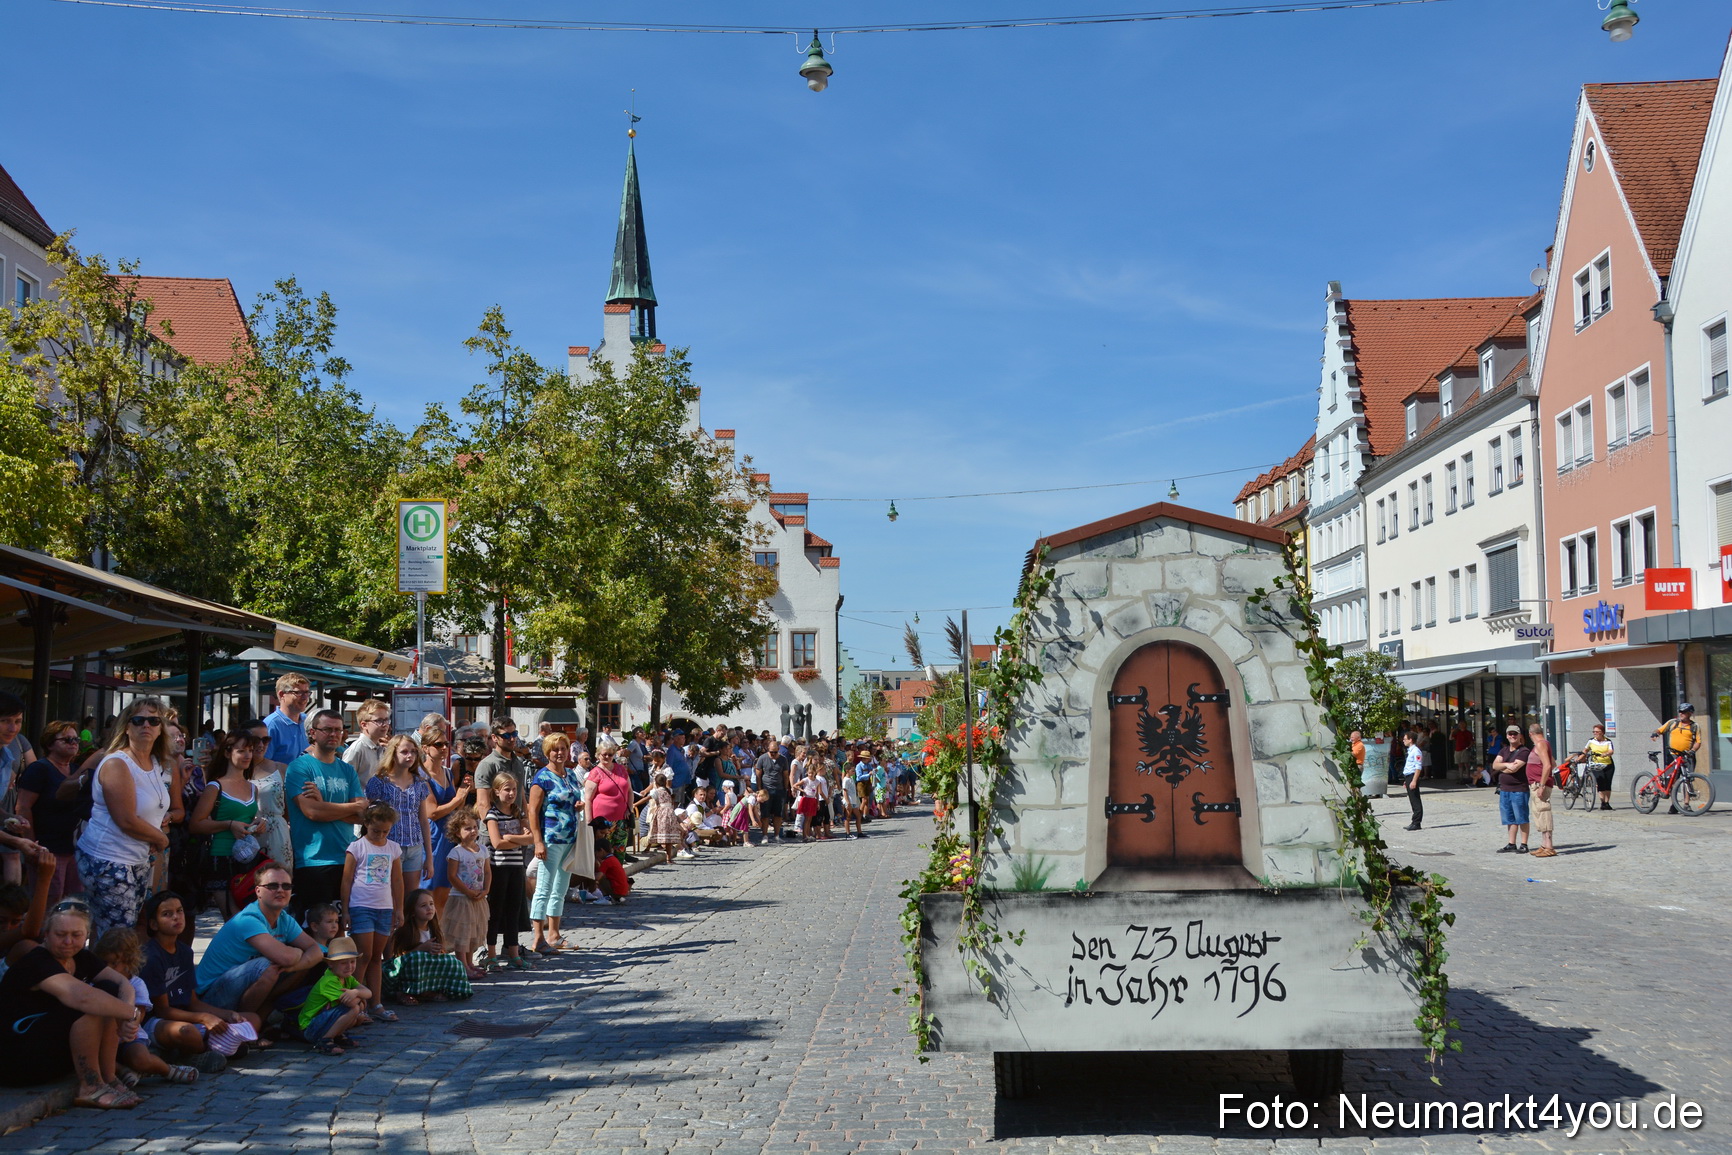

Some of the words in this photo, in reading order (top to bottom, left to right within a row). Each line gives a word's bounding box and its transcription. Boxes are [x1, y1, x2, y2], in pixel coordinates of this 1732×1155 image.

[413, 514, 431, 534] H
[1654, 582, 1686, 592] WITT
[1071, 930, 1117, 961] den
[1126, 923, 1178, 963] 23
[1185, 919, 1282, 966] August
[1066, 965, 1093, 1005] in
[1096, 963, 1188, 1020] Jahr
[1204, 962, 1287, 1018] 1796
